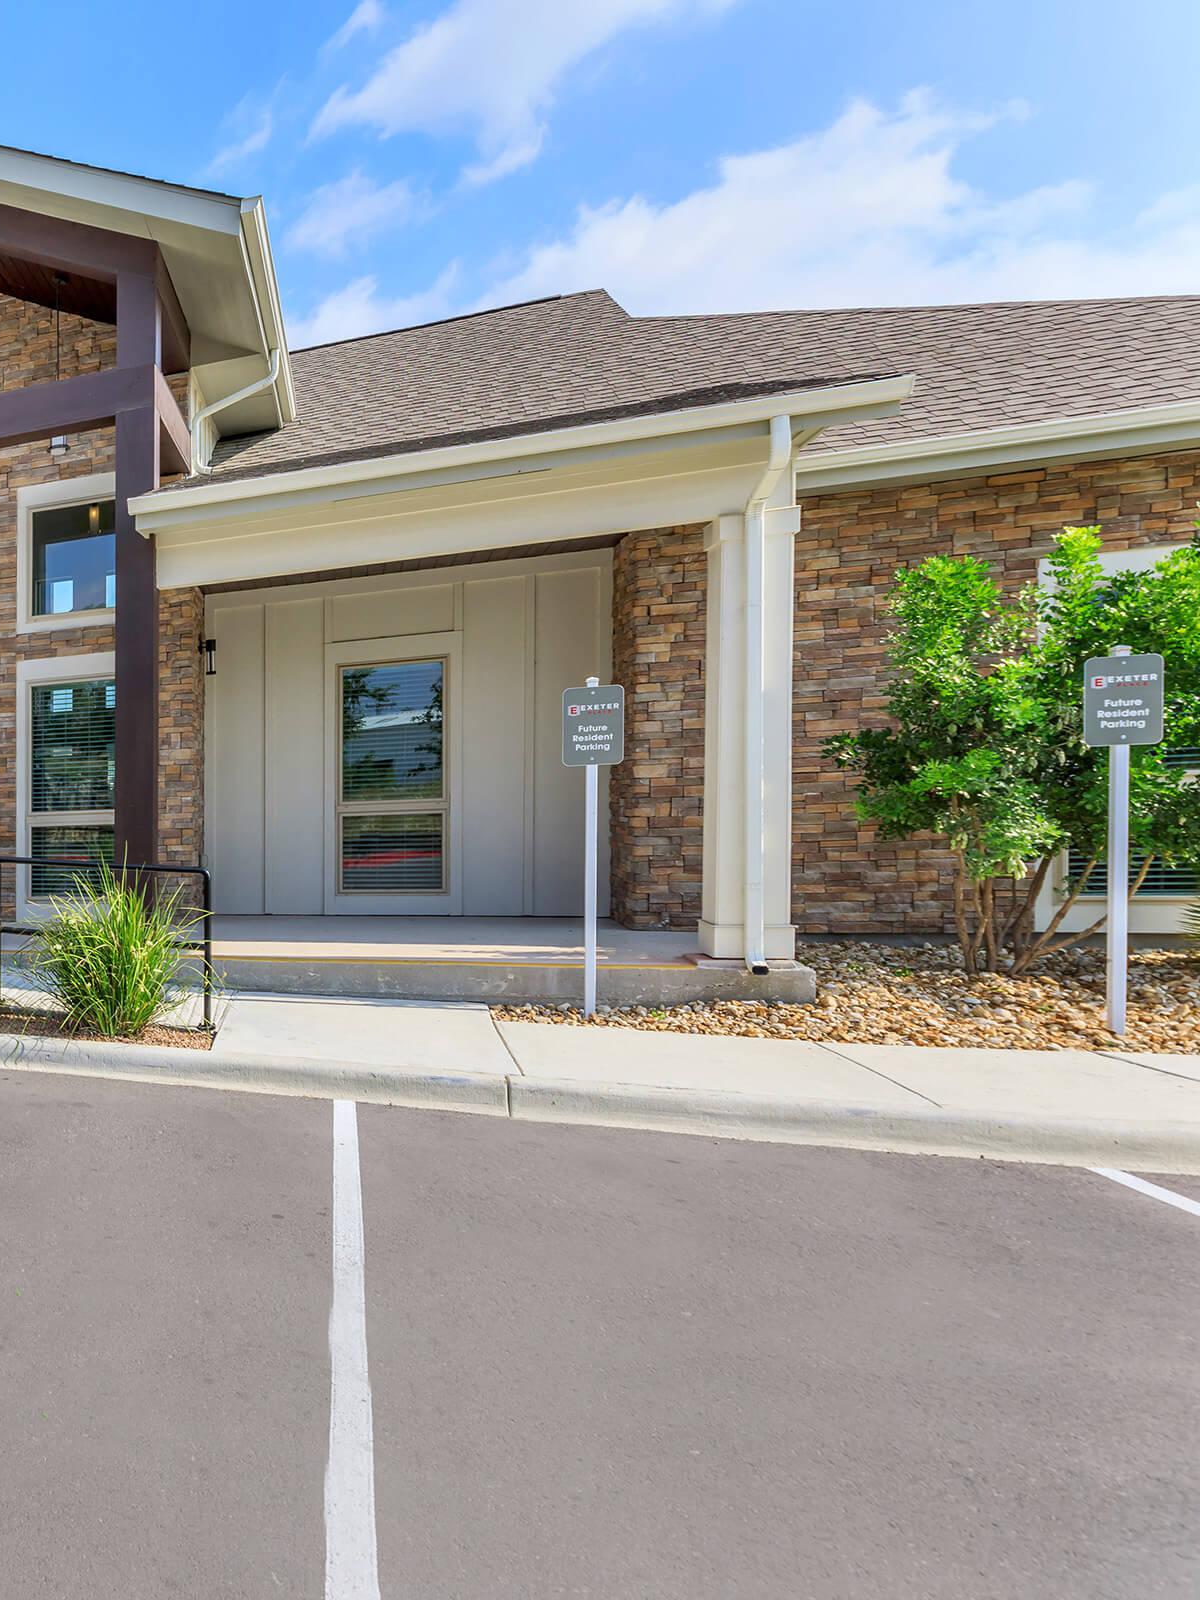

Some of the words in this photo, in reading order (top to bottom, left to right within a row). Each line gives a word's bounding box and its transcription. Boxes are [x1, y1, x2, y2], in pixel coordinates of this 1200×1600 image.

[1107, 673, 1158, 684] EXETER
[580, 702, 620, 711] EXETER
[1104, 698, 1143, 707] Future
[1096, 708, 1150, 718] Resident
[578, 725, 608, 733] Future
[1100, 720, 1146, 729] Parking
[572, 733, 614, 742] Resident
[575, 743, 610, 751] Parking
